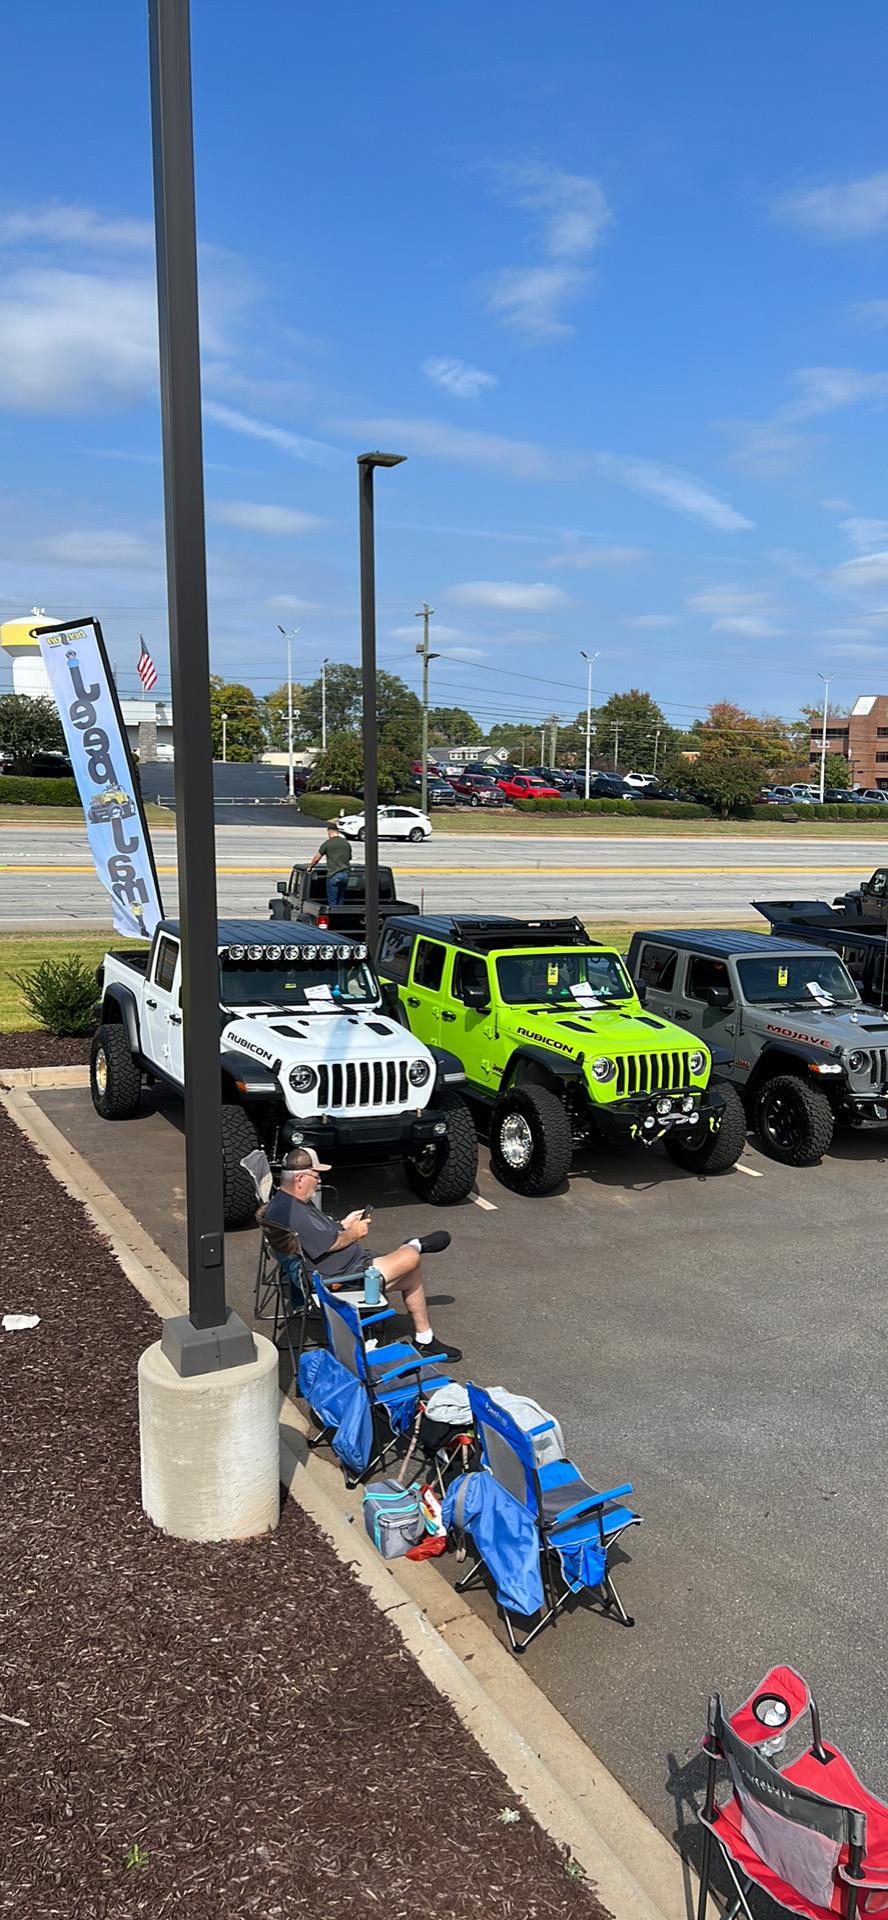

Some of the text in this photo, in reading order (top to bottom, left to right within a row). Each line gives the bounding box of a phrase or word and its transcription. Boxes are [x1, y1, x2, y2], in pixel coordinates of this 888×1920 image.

[227, 1031, 273, 1060] RUBICON
[517, 1027, 574, 1053] RUBICON
[766, 1023, 833, 1048] MOJAVE
